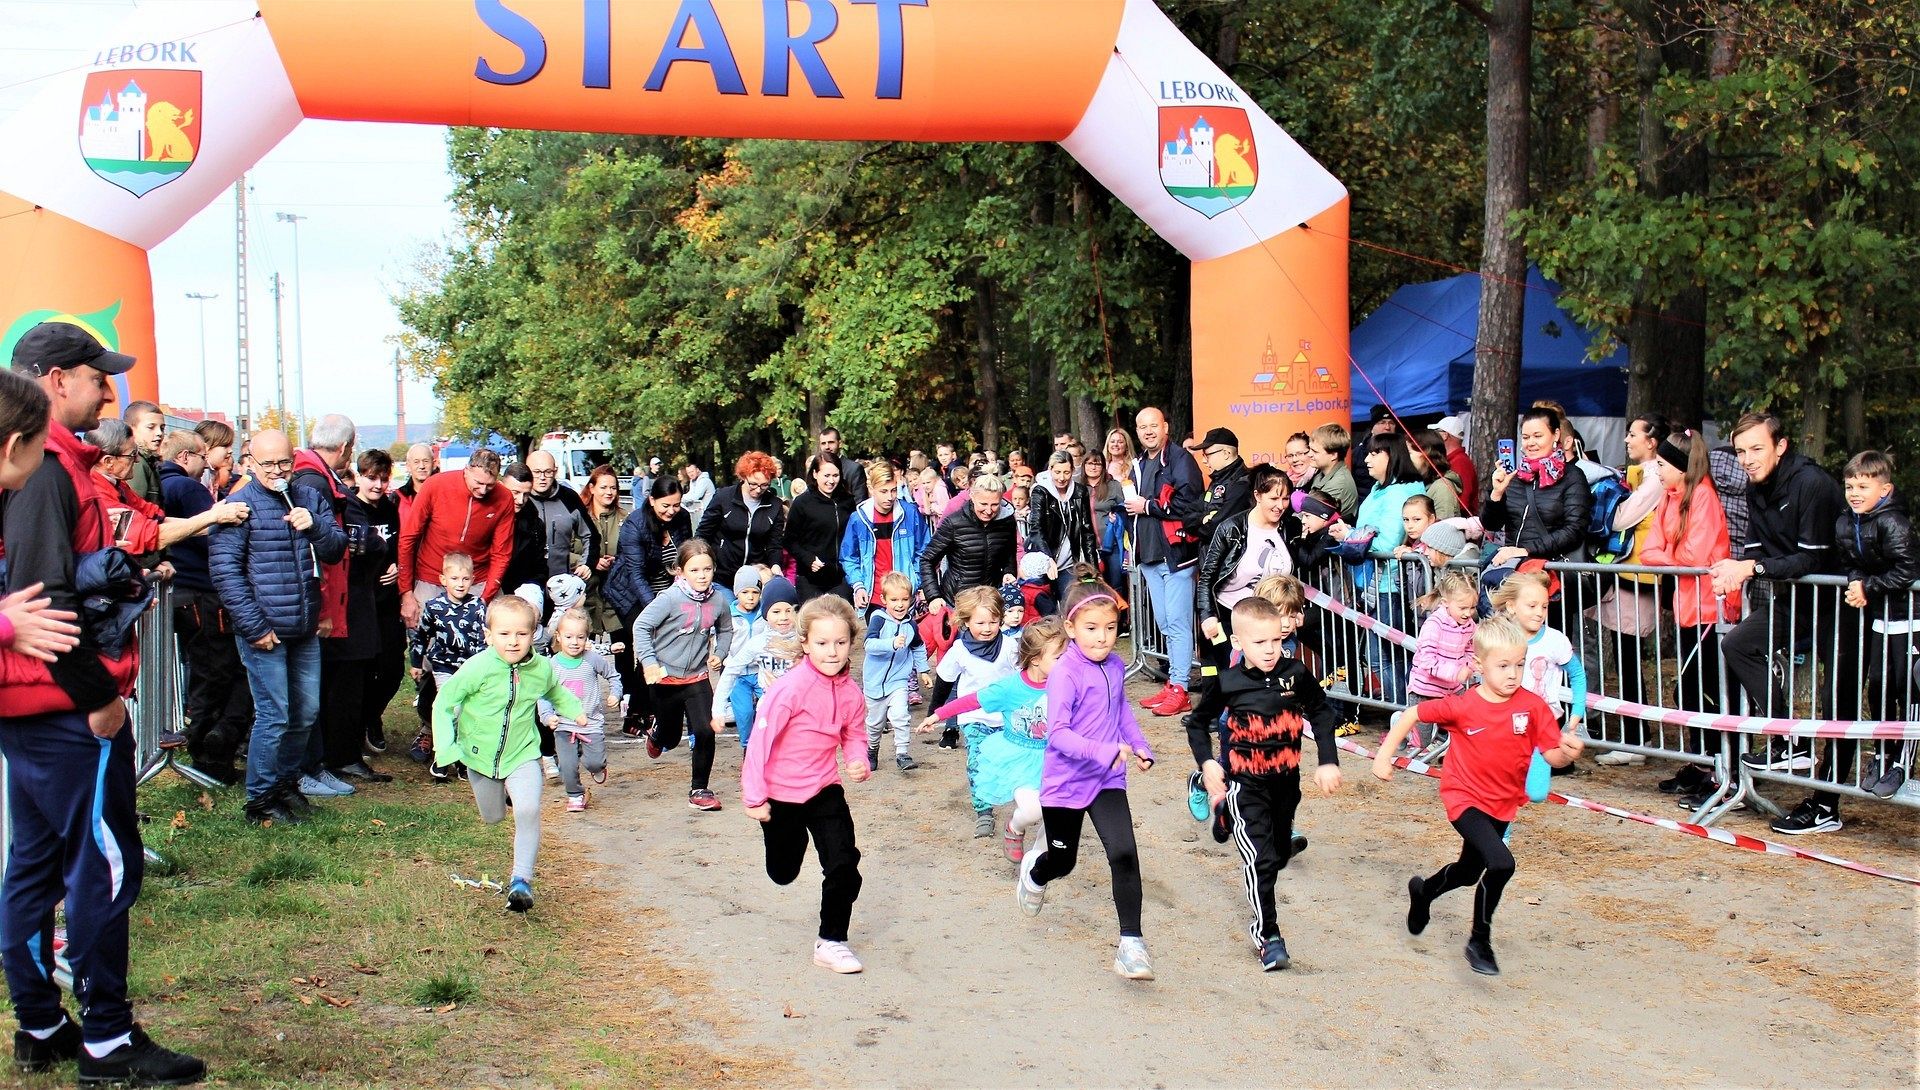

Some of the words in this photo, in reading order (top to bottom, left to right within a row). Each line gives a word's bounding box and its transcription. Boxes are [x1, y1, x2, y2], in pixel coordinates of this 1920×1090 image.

[94, 42, 198, 67] LĘBORK
[474, 0, 928, 100] START
[1160, 80, 1239, 103] LĘBORK
[1252, 453, 1287, 465] POLU
